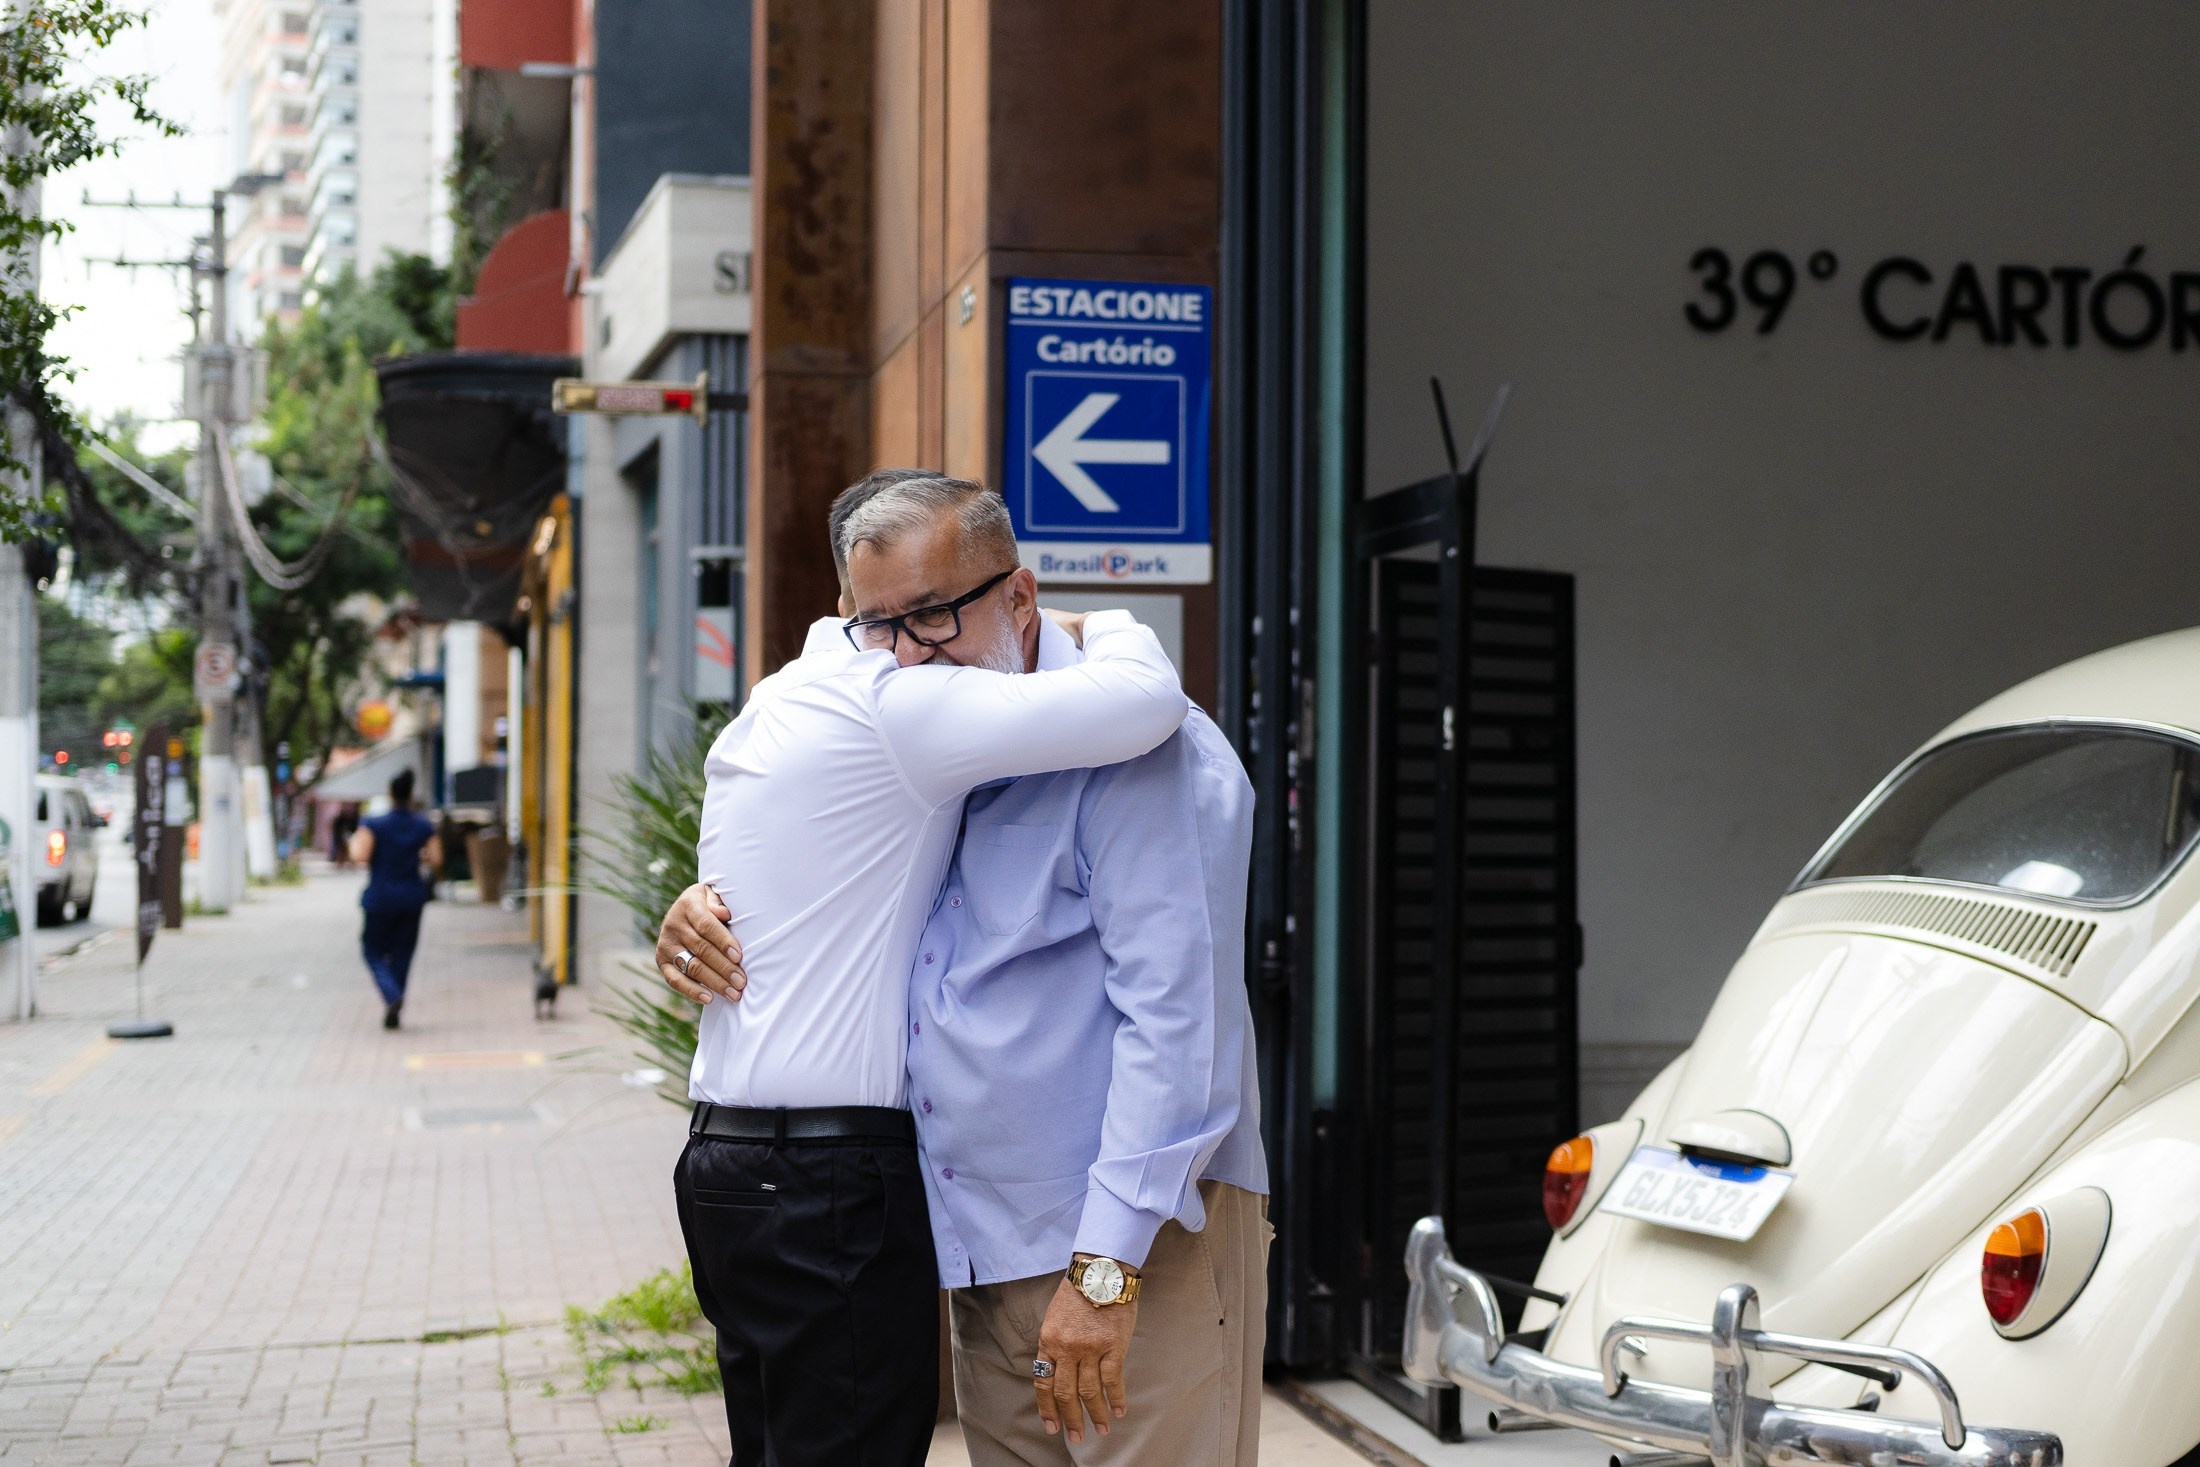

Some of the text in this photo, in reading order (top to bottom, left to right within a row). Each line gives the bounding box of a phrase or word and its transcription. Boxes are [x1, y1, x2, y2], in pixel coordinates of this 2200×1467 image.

[1009, 285, 1203, 323] ESTACIONE
[1684, 247, 1839, 336] 39°
[1036, 334, 1177, 367] Cartório
[1621, 1169, 1760, 1230] GLX5J24
